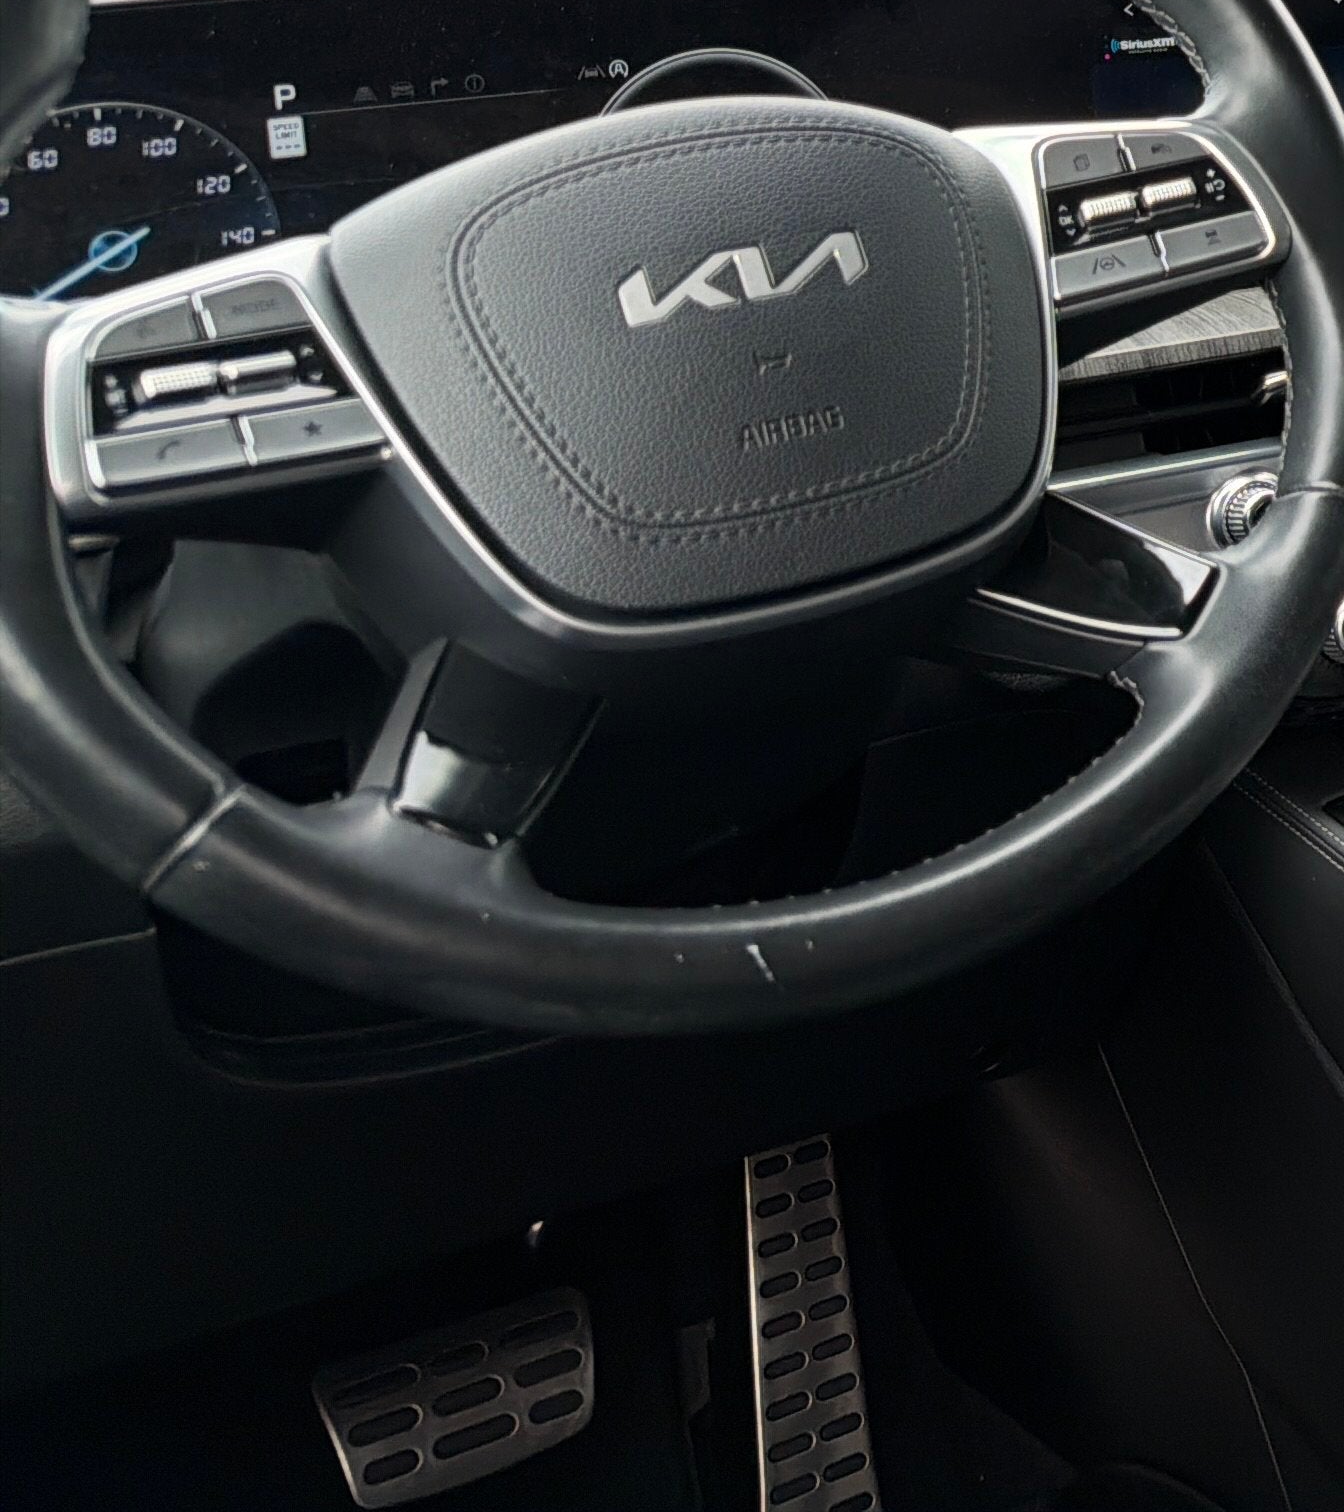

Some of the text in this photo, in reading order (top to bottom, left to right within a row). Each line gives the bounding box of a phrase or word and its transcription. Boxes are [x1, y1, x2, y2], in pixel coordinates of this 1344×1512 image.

[273, 84, 296, 110] P
[273, 122, 300, 131] SPEED
[276, 131, 297, 140] LIMIT
[87, 126, 117, 148] 80
[142, 137, 177, 157] 100
[27, 148, 58, 170] 60
[197, 175, 231, 195] 120
[1058, 214, 1074, 226] OK
[221, 227, 255, 246] 140
[618, 230, 869, 328] KIA
